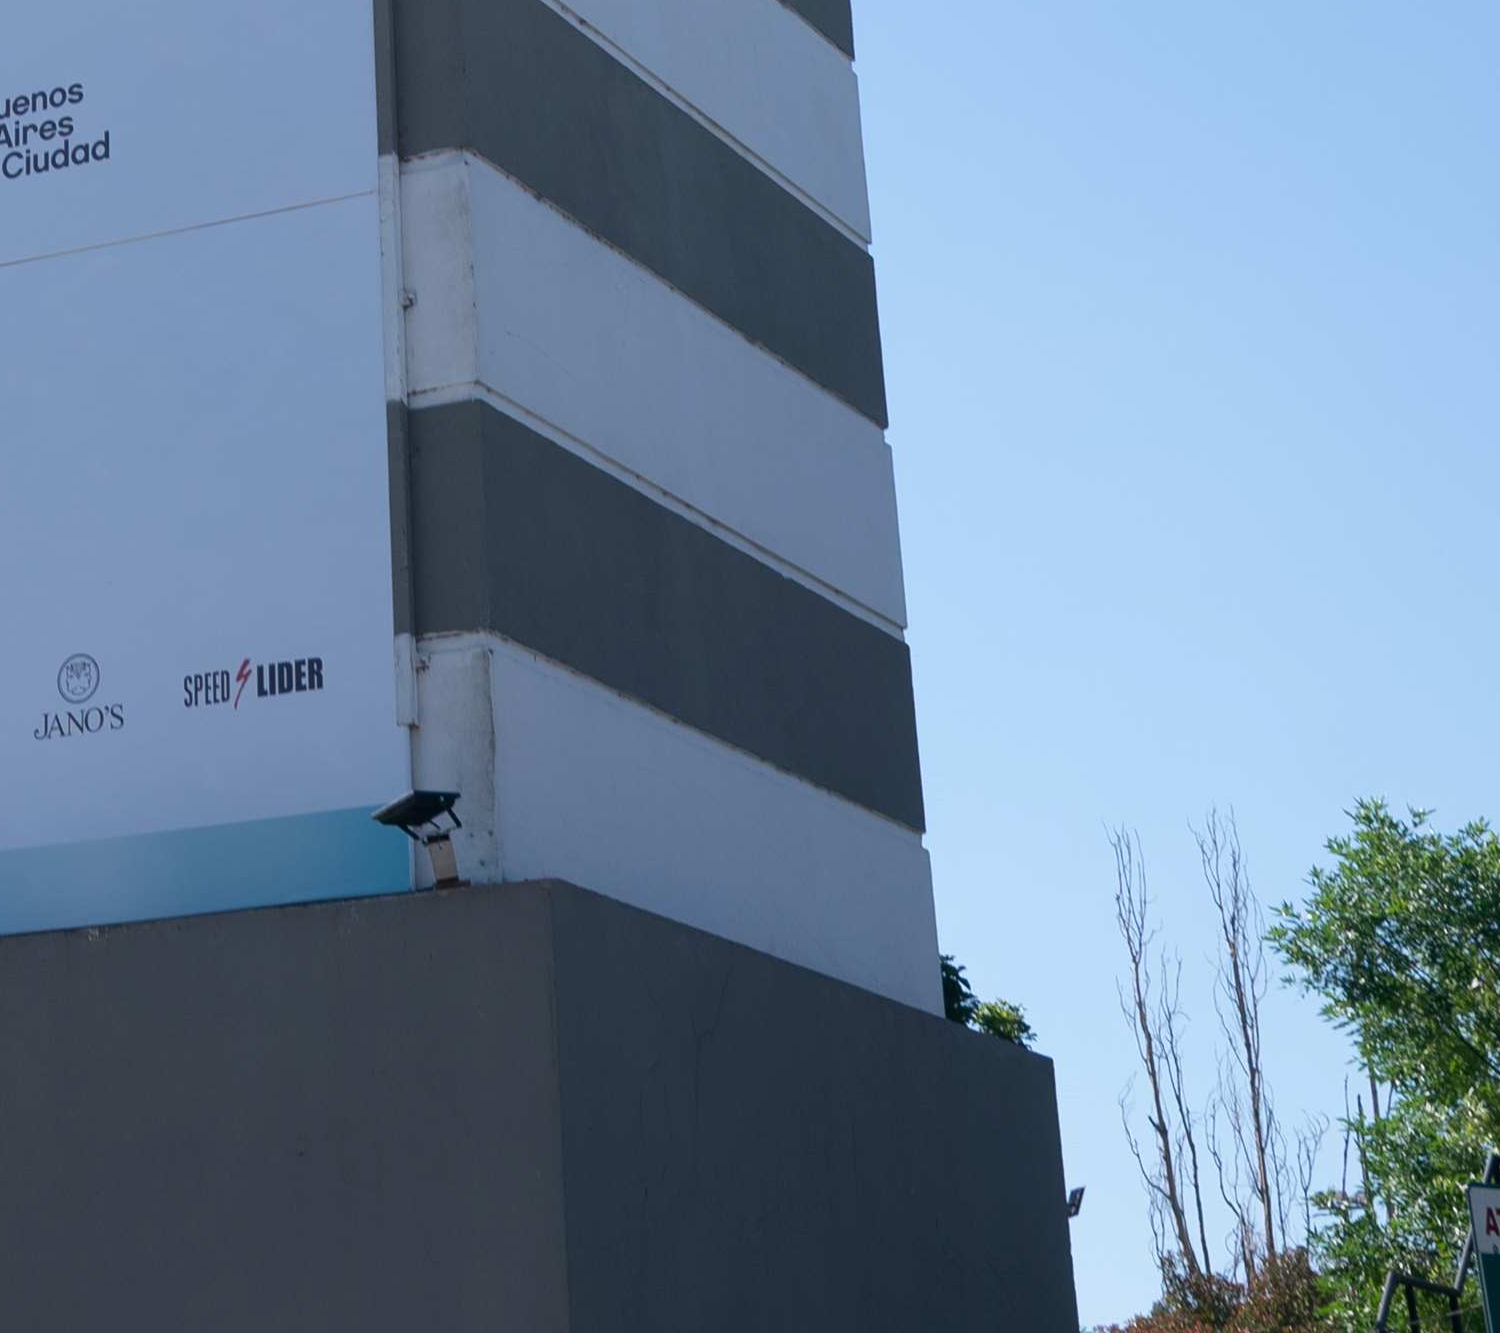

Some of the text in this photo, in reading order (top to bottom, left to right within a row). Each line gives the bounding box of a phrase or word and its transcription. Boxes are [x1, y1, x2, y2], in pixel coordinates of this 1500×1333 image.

[2, 130, 110, 179] Ciudad
[183, 657, 324, 708] SPEED LIDER
[33, 703, 125, 741] JANO'S
